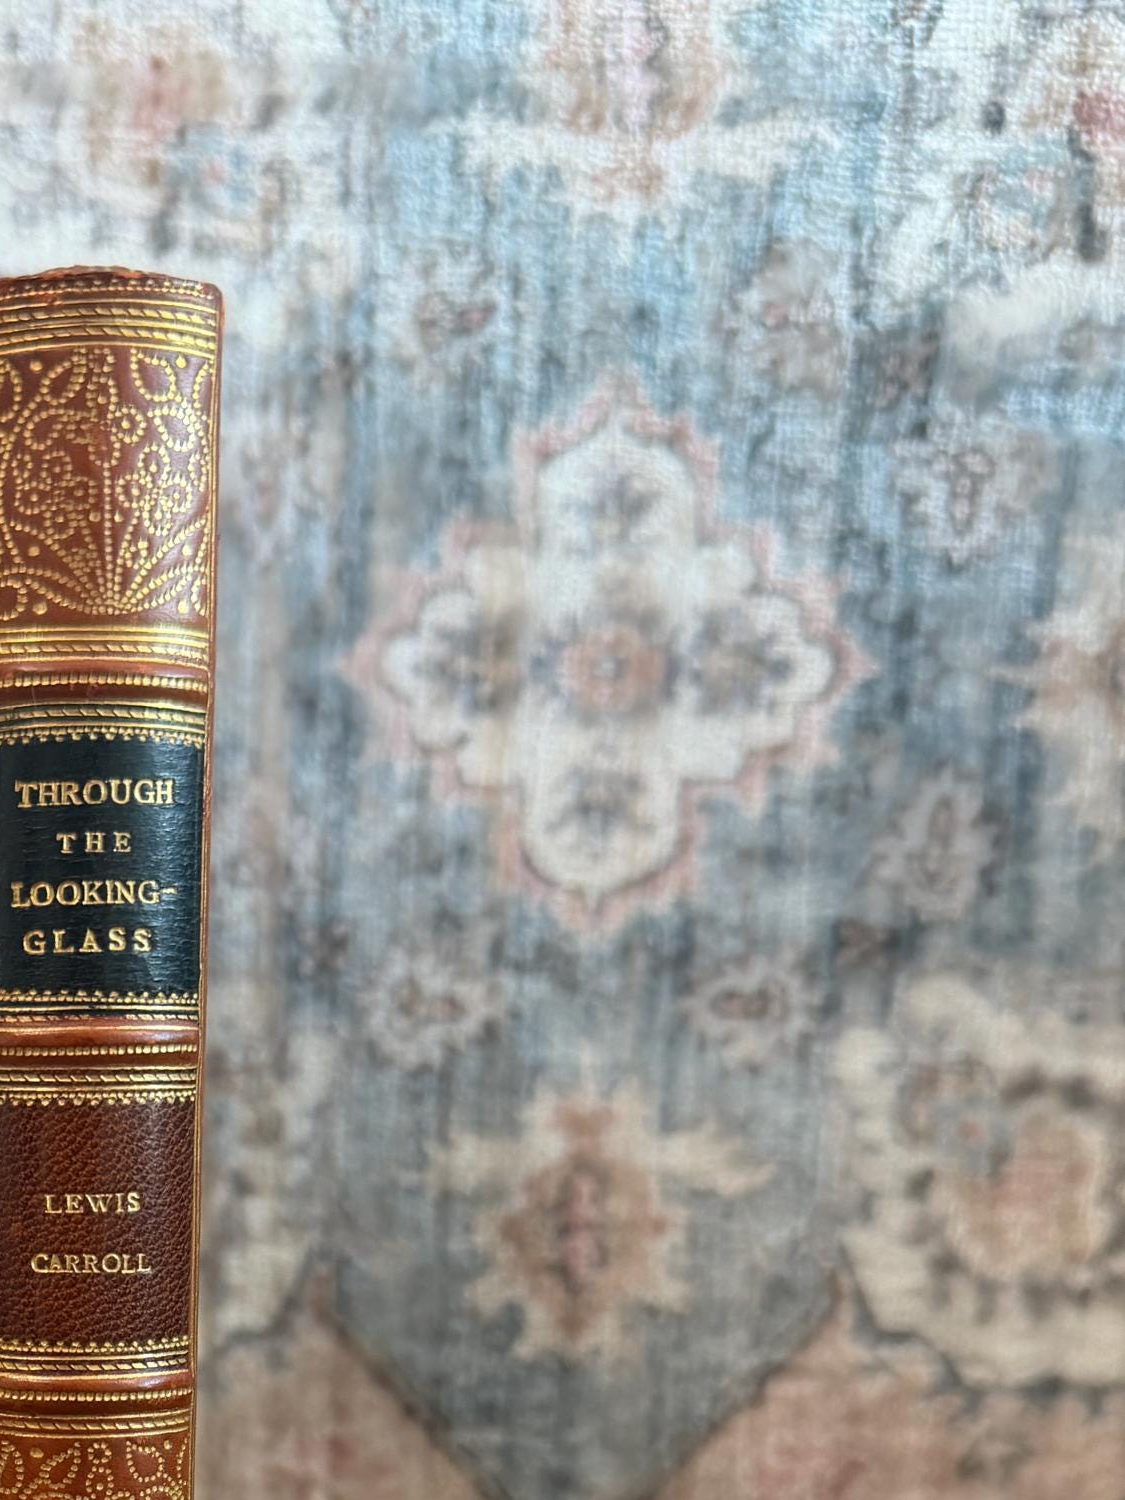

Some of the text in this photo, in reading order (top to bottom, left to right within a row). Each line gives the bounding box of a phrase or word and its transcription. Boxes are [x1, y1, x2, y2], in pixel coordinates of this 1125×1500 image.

[15, 779, 173, 808] THROUGH
[56, 832, 132, 853] THE
[11, 880, 176, 908] LOOKING-
[22, 927, 154, 956] GLASS
[44, 1191, 141, 1214] LEWIS
[31, 1252, 152, 1274] CARROLL
